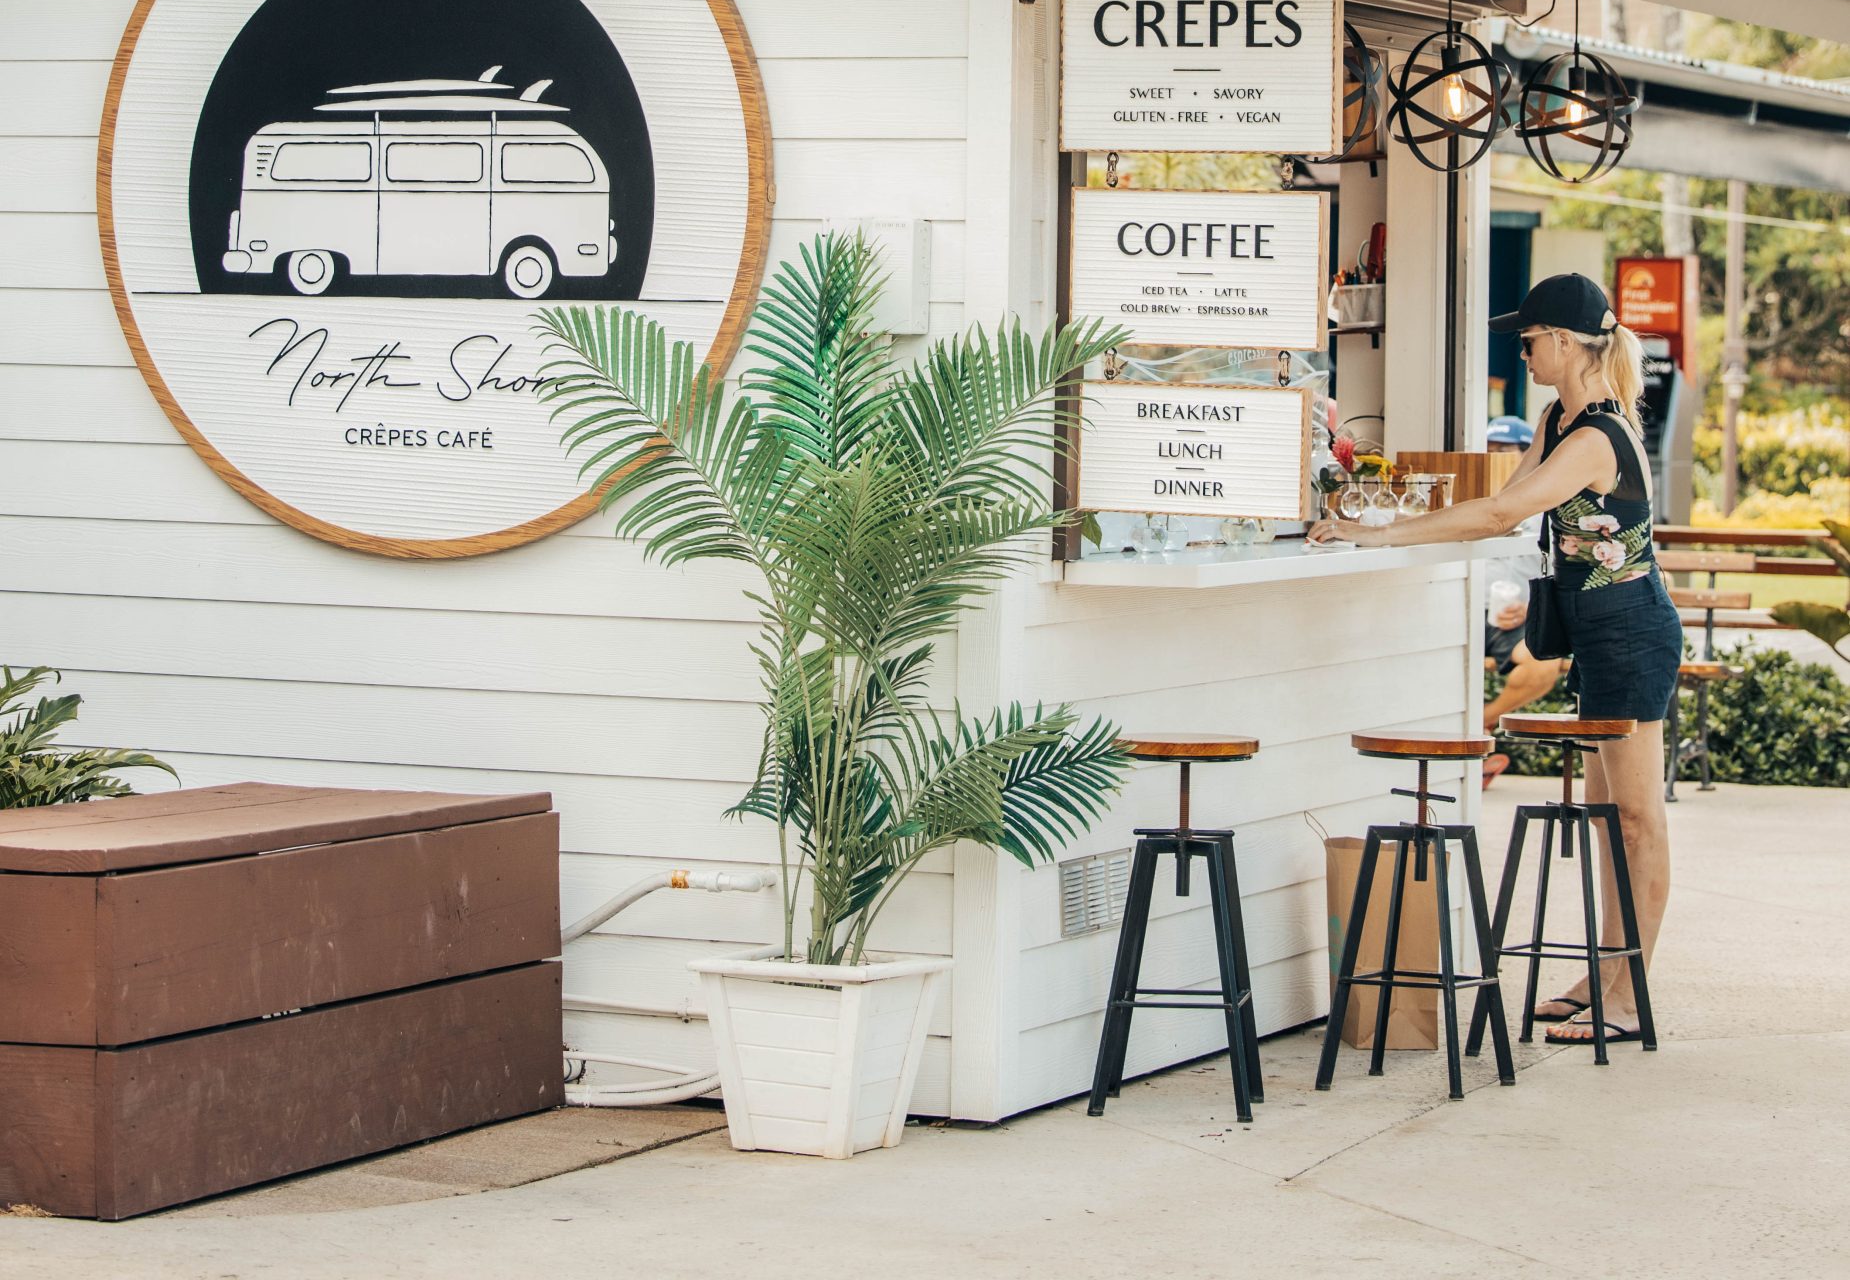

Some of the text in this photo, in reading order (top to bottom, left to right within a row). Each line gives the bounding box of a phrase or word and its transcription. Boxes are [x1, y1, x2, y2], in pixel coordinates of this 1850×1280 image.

[1093, 0, 1302, 48] CREPES
[1129, 87, 1264, 100] SWEET SAVORY
[1236, 111, 1281, 123] VEGAN
[1117, 222, 1275, 259] COFFEE
[1142, 286, 1248, 297] ICED TEA LATTE
[1120, 303, 1269, 316] COLD BREW ESPRESSO BAR
[249, 318, 421, 413] North
[1137, 402, 1246, 422] BREAKFAST
[344, 422, 494, 449] CRÊPES CAFÉ
[1158, 441, 1222, 460] LUNCH
[1153, 479, 1224, 498] DINNER
